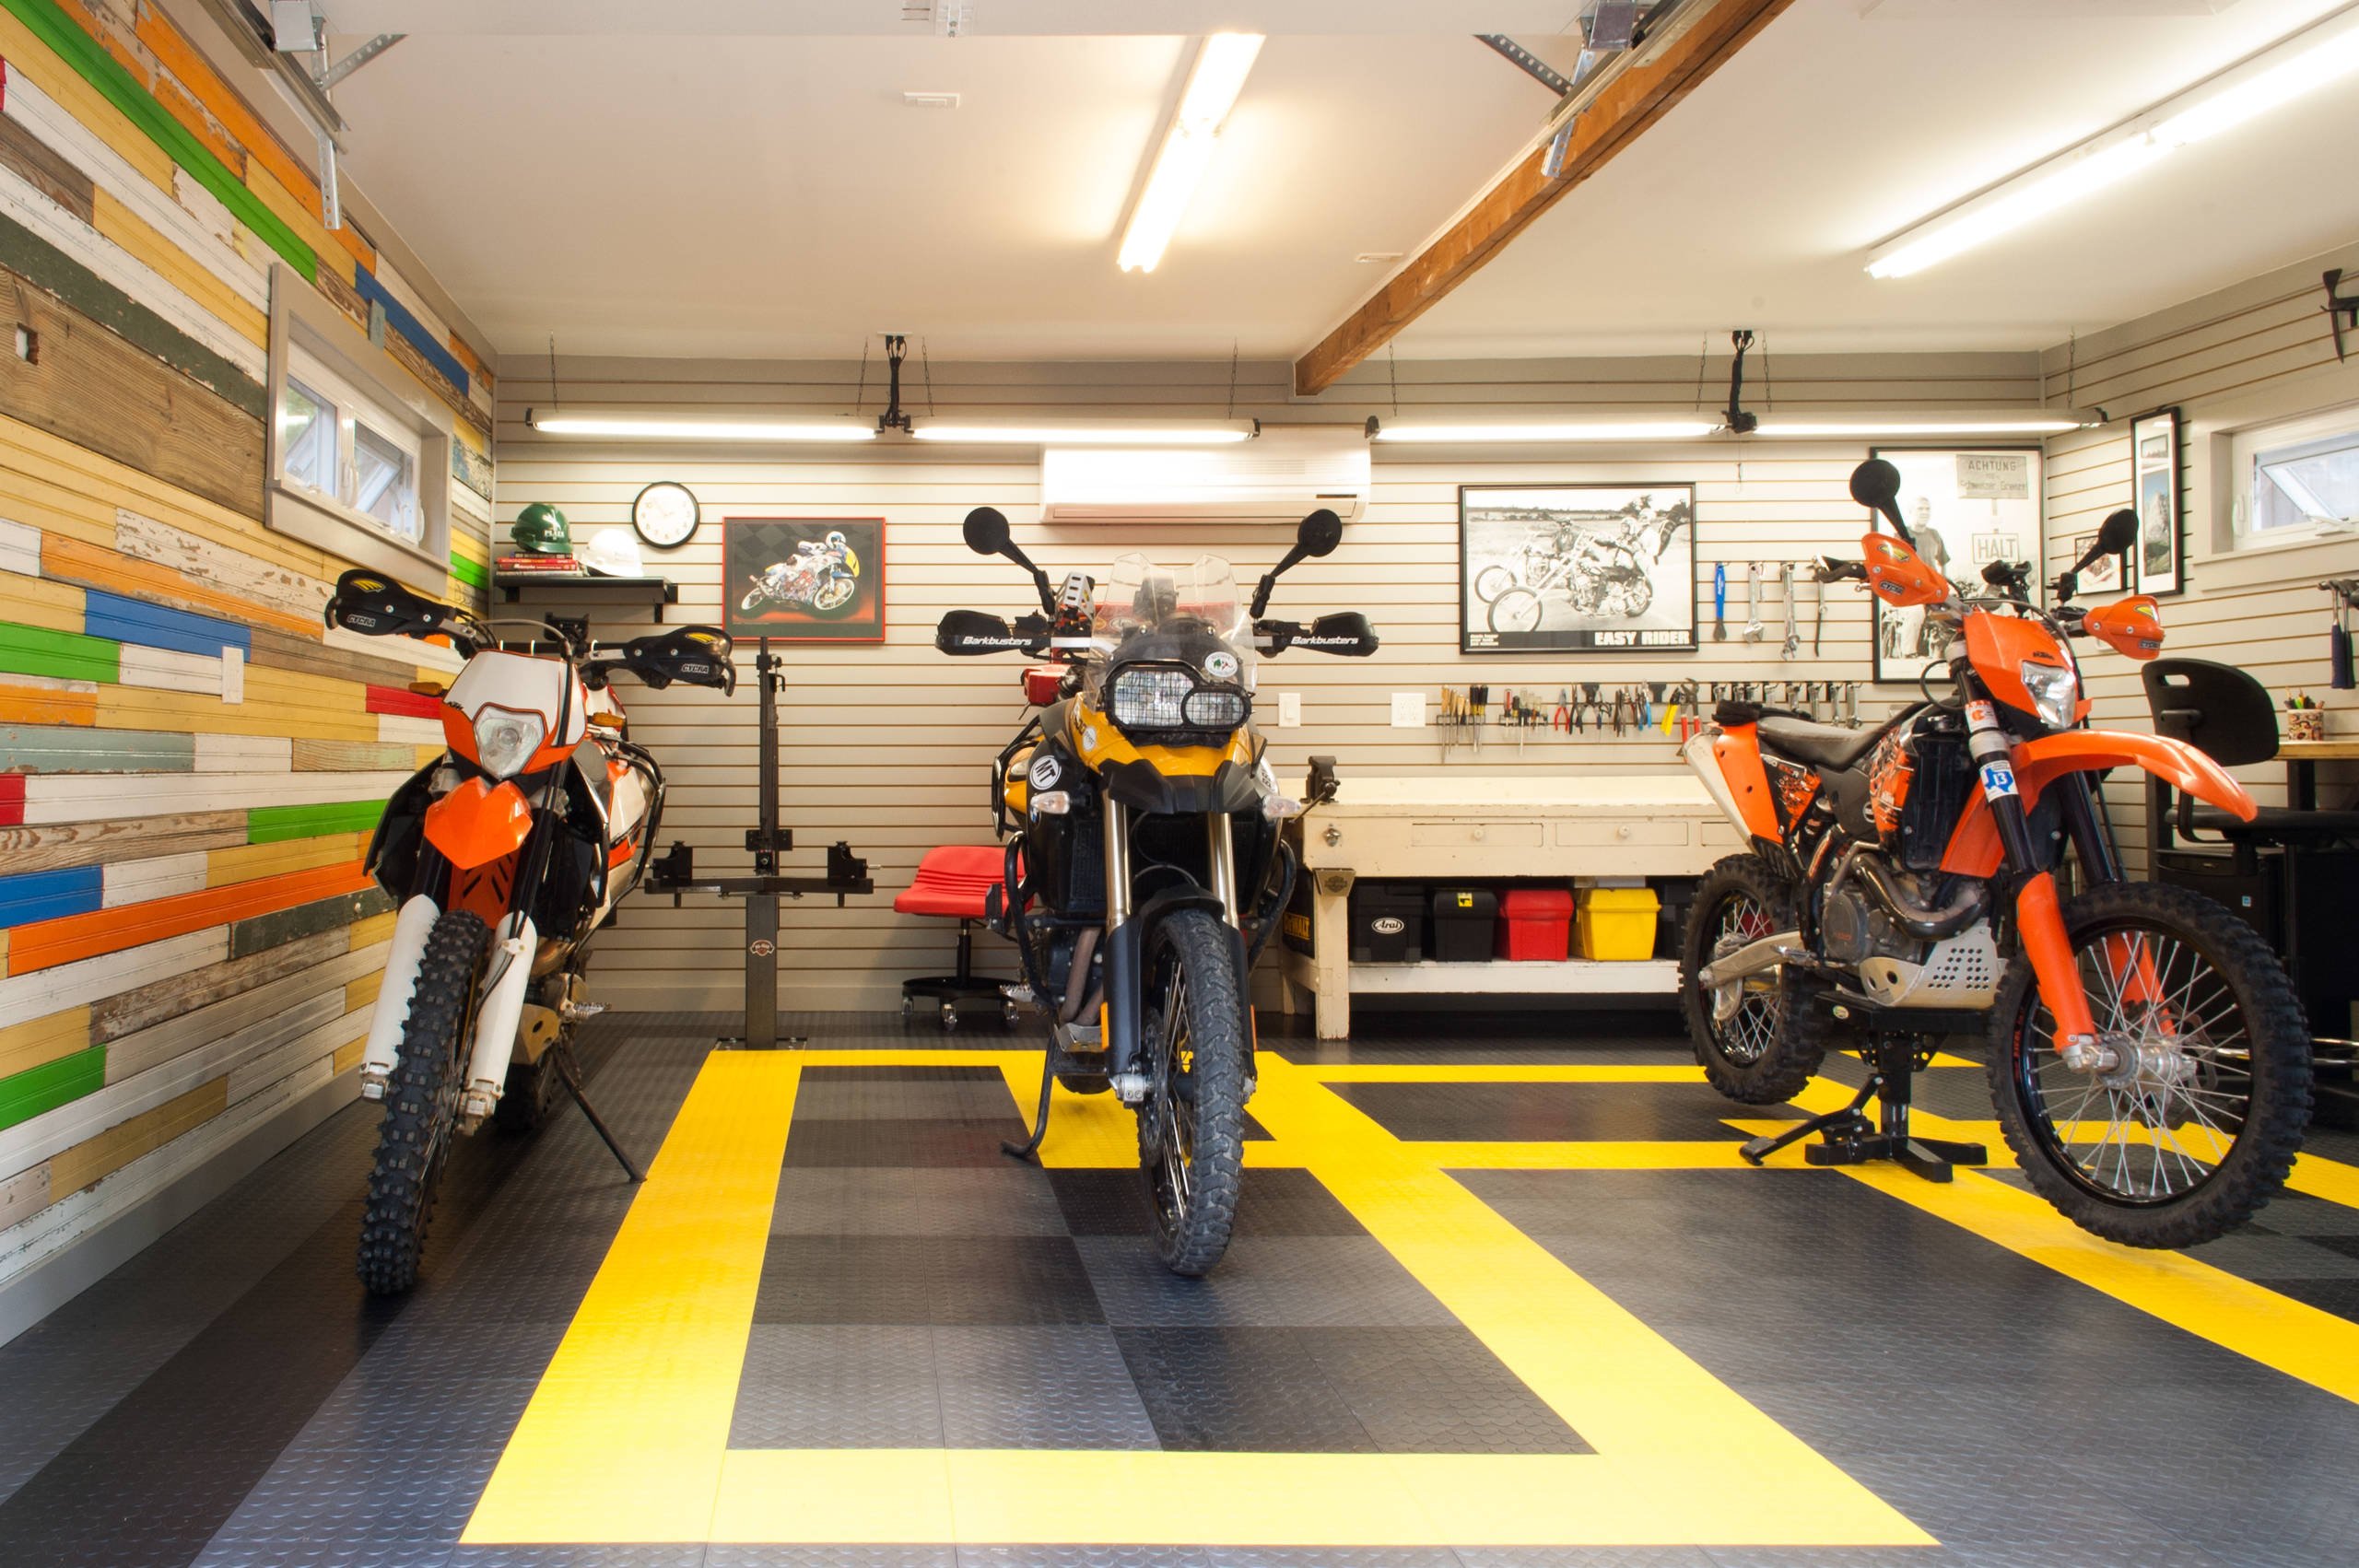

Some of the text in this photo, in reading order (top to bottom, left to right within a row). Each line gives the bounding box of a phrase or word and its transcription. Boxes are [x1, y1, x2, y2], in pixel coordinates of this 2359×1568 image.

[1967, 460, 2016, 472] ACHTUNG
[1978, 538, 2016, 560] HALT
[962, 636, 1033, 646] Barkbusters
[1290, 636, 1359, 645] Barkbusters
[1594, 631, 1690, 646] EASY RIDER
[1035, 759, 1057, 783] MT
[1377, 919, 1399, 929] Arai
